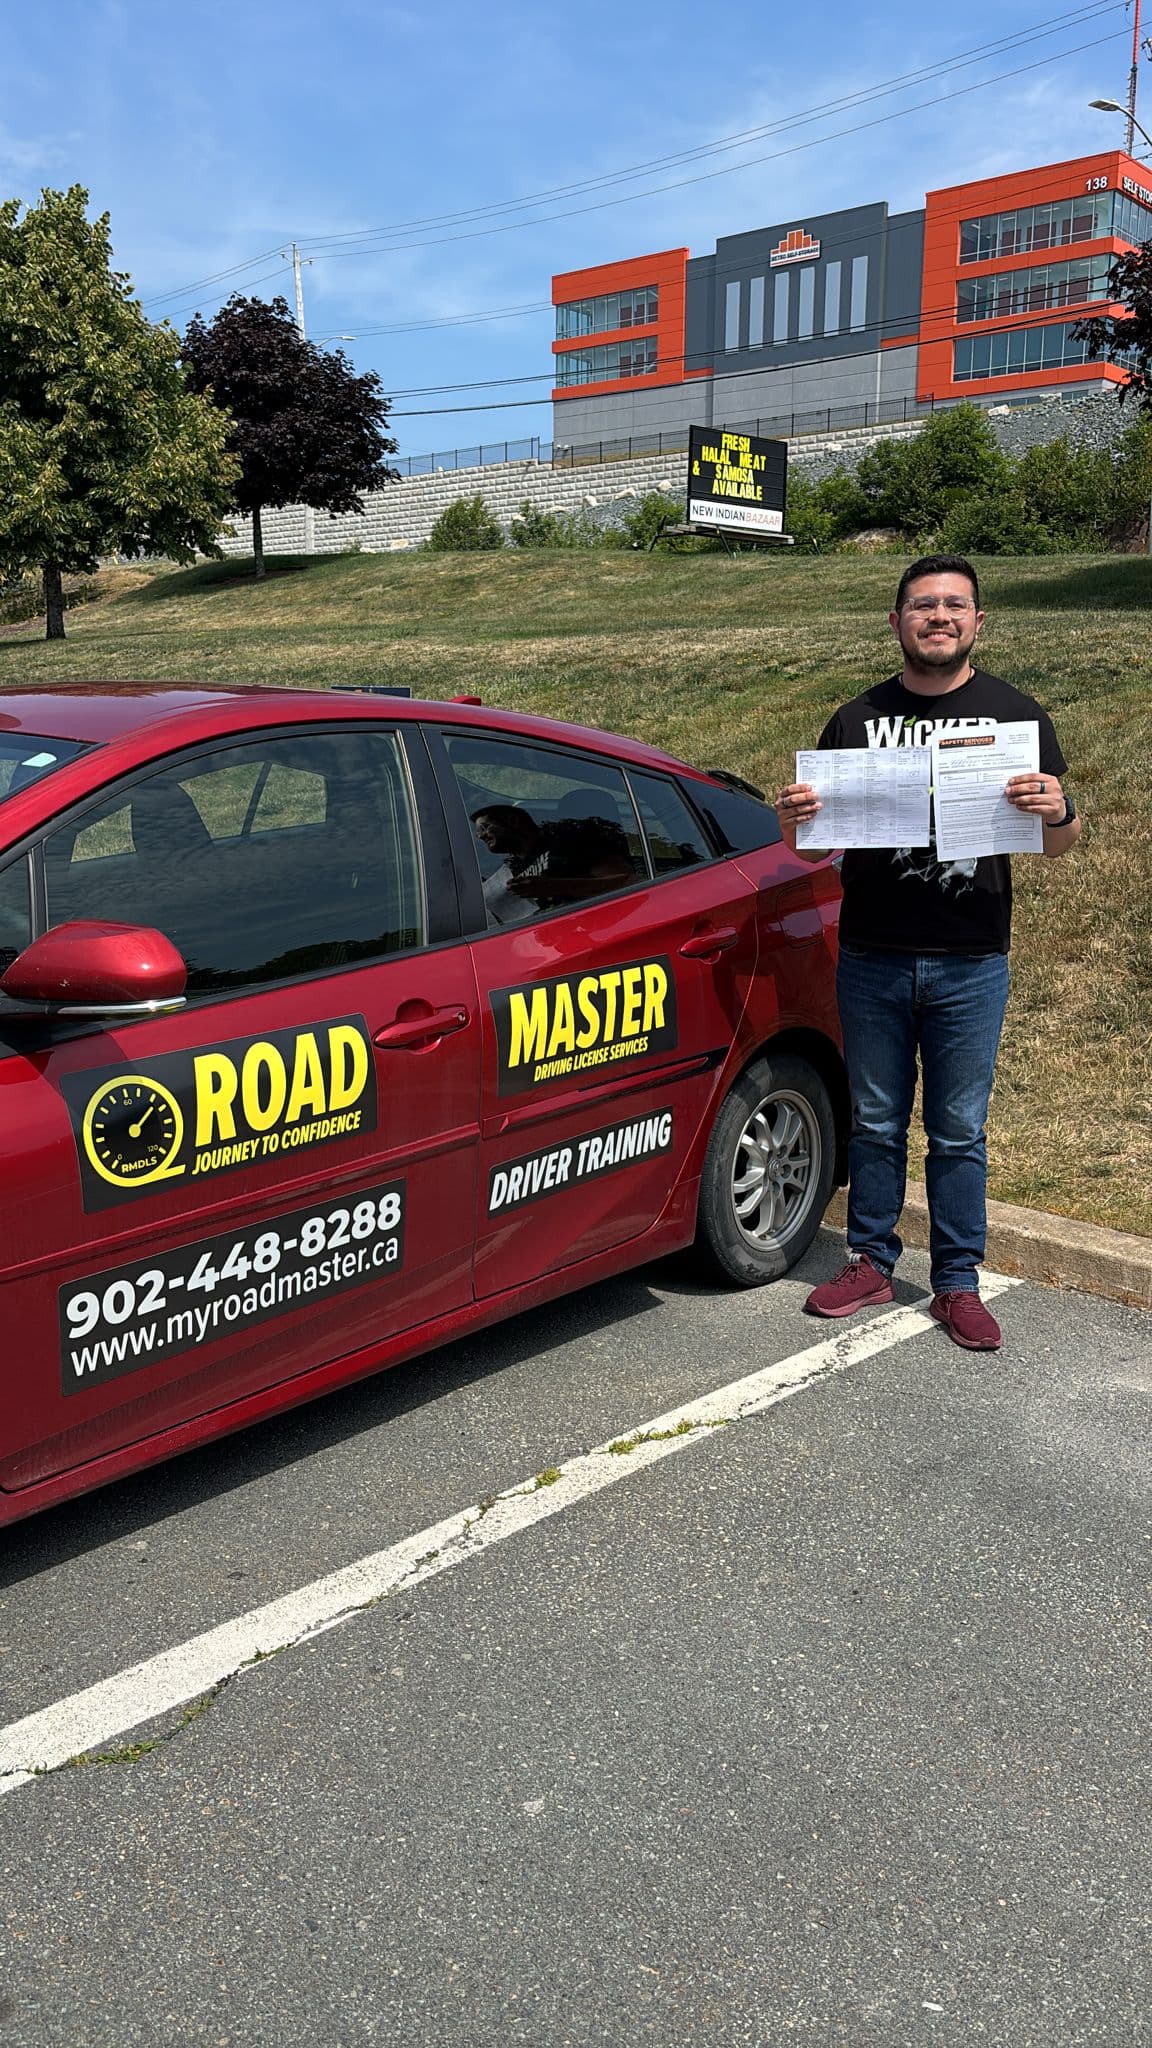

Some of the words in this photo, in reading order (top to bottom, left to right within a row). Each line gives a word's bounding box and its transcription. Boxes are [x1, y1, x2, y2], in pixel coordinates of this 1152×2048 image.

[1086, 176, 1108, 191] 138
[1123, 176, 1139, 194] SELF
[722, 433, 750, 452] FRESH
[702, 446, 731, 465] HALAL
[740, 452, 766, 471] MEAT
[692, 460, 700, 476] &
[715, 464, 754, 484] SAMOSA
[712, 479, 763, 501] AVAILABLE
[692, 505, 713, 517] NEW
[508, 963, 668, 1068] MASTER
[534, 1054, 573, 1082] DRIVING
[573, 1045, 609, 1069] LICENSE
[609, 1036, 648, 1061] SERVICES
[193, 1025, 368, 1147] ROAD
[123, 1098, 133, 1106] 60
[147, 1144, 159, 1152] 120
[191, 1138, 260, 1175] JOURNEY
[262, 1133, 280, 1155] TO
[281, 1110, 362, 1149] CONFIDENCE
[121, 1156, 157, 1173] RMDLS
[489, 1147, 572, 1211] DRIVER
[576, 1113, 672, 1177] TRAINING
[66, 1193, 401, 1339] 902-448-8288
[70, 1237, 399, 1377] www.myroadmaster.ca
